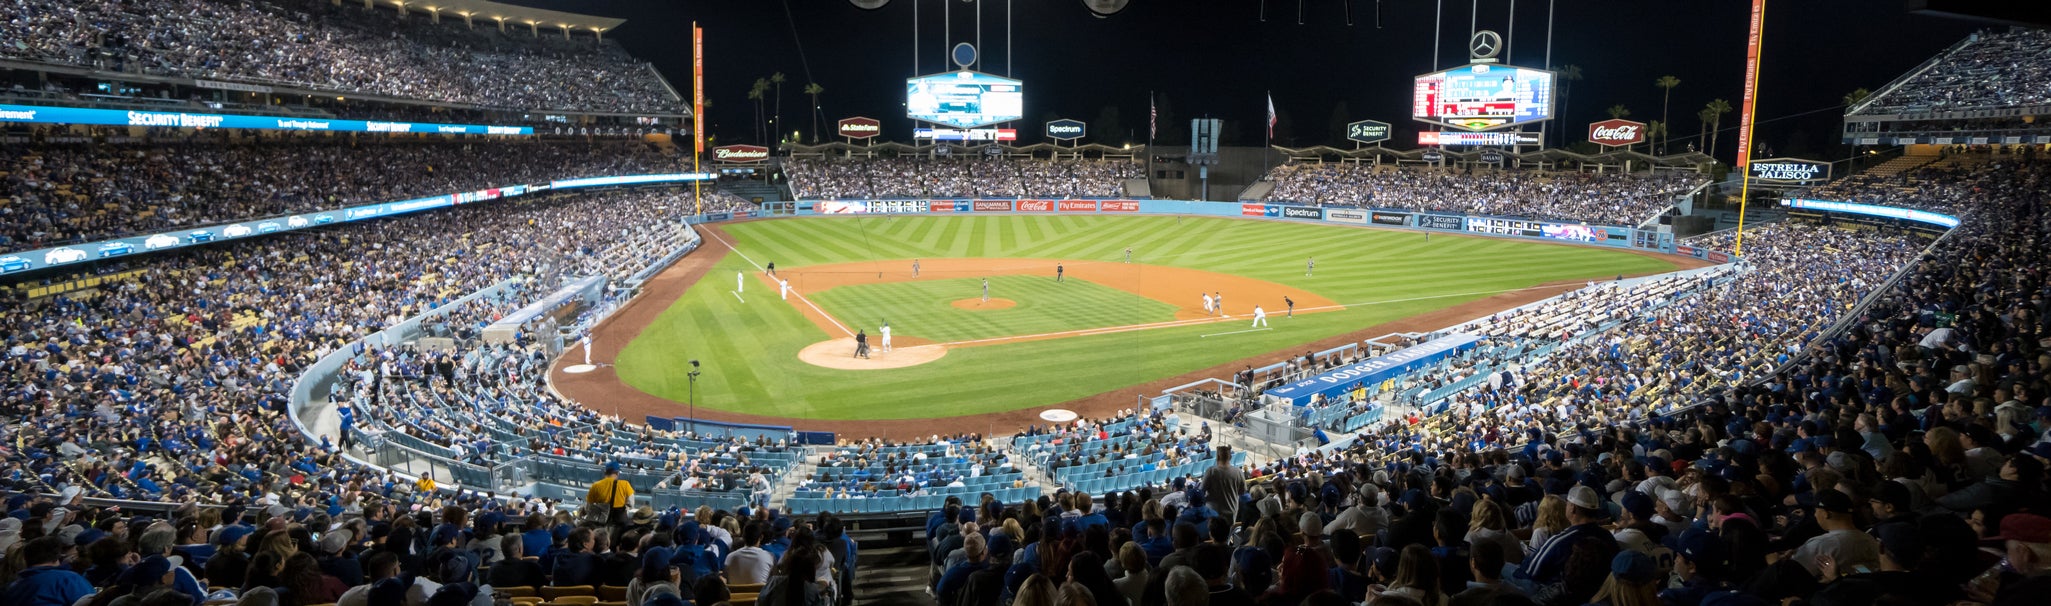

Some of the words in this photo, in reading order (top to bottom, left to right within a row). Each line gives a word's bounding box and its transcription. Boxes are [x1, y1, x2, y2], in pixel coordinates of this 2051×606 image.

[128, 111, 179, 126] SECURITY
[1050, 125, 1080, 134] Spectrum
[1592, 125, 1639, 140] Coca-Cola
[716, 149, 767, 158] Budweiser
[1753, 163, 1819, 173] ESTRELLA
[1758, 171, 1811, 180] JALISCO
[1021, 201, 1048, 210] Coca-Cola
[1286, 208, 1318, 217] Spectrum
[1320, 360, 1389, 384] DODGER
